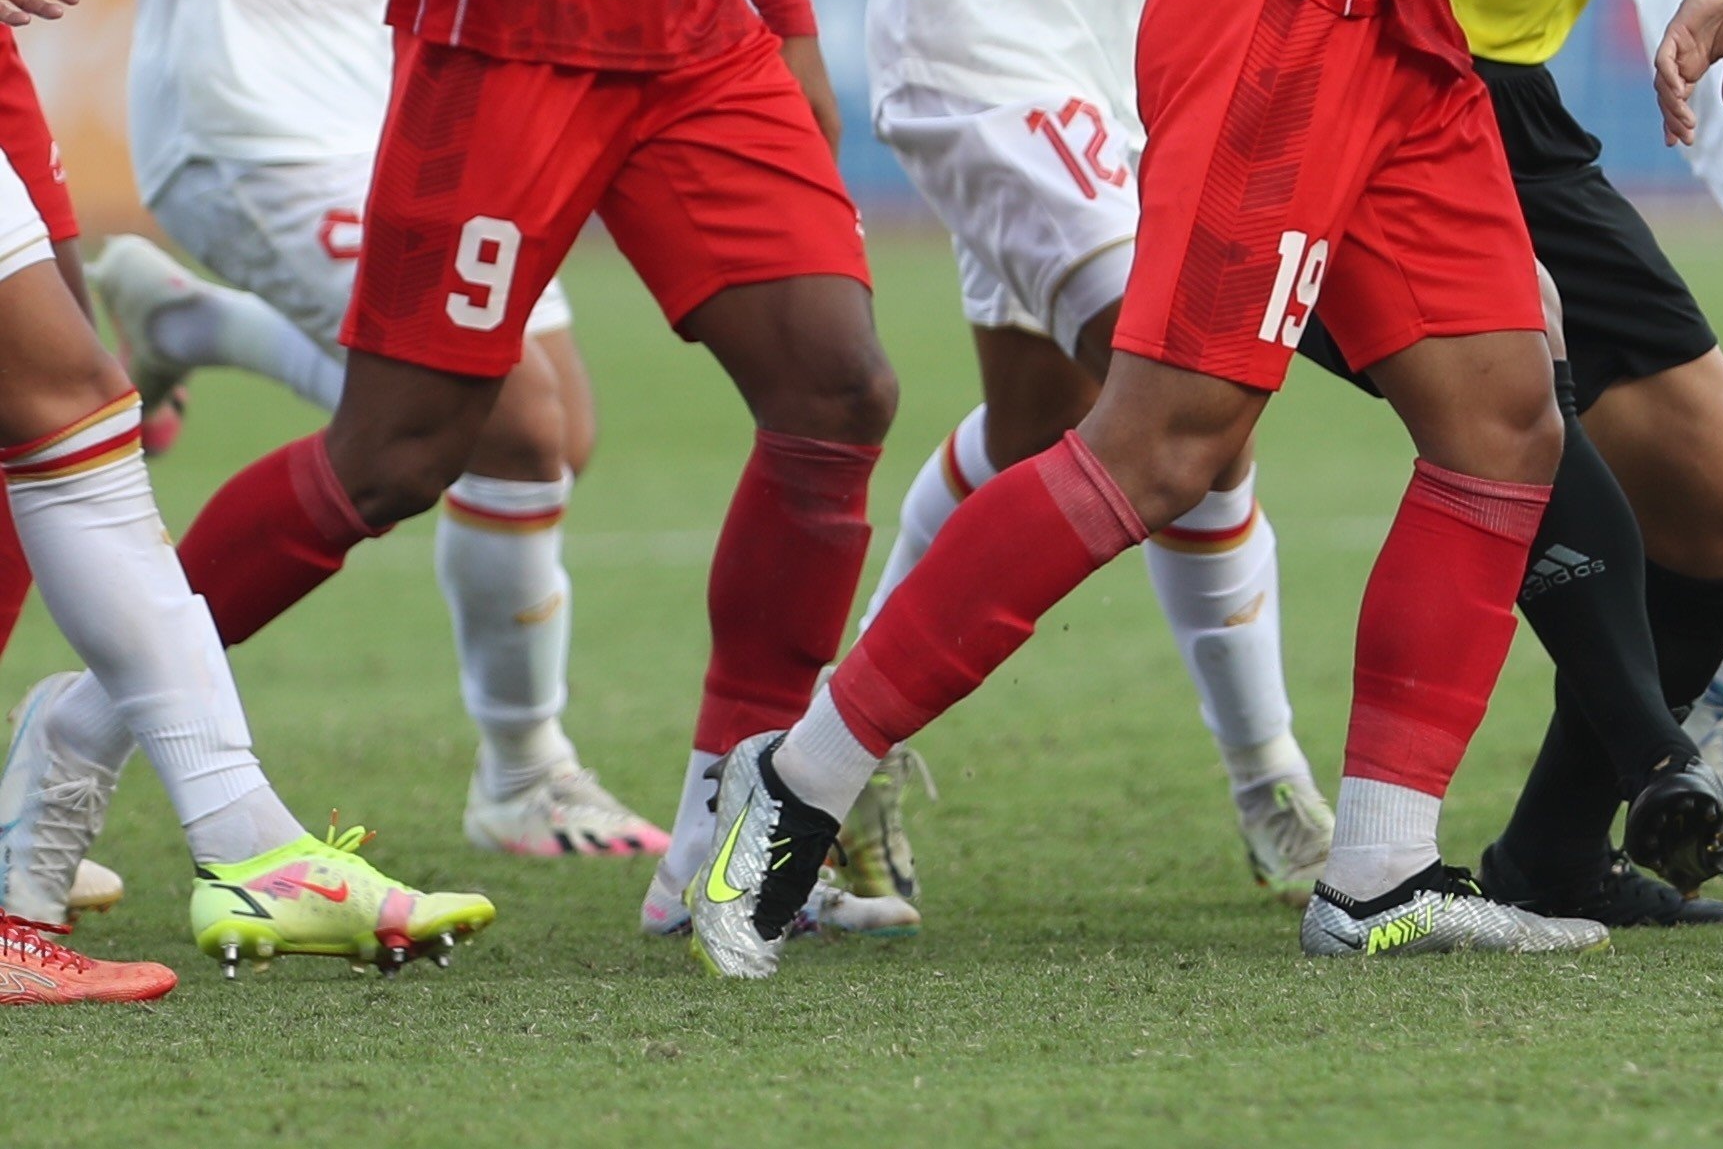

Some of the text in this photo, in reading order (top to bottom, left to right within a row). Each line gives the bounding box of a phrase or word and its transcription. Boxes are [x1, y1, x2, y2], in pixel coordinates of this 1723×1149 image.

[1024, 96, 1129, 200] 12
[445, 215, 523, 331] 9
[1258, 230, 1329, 350] 19
